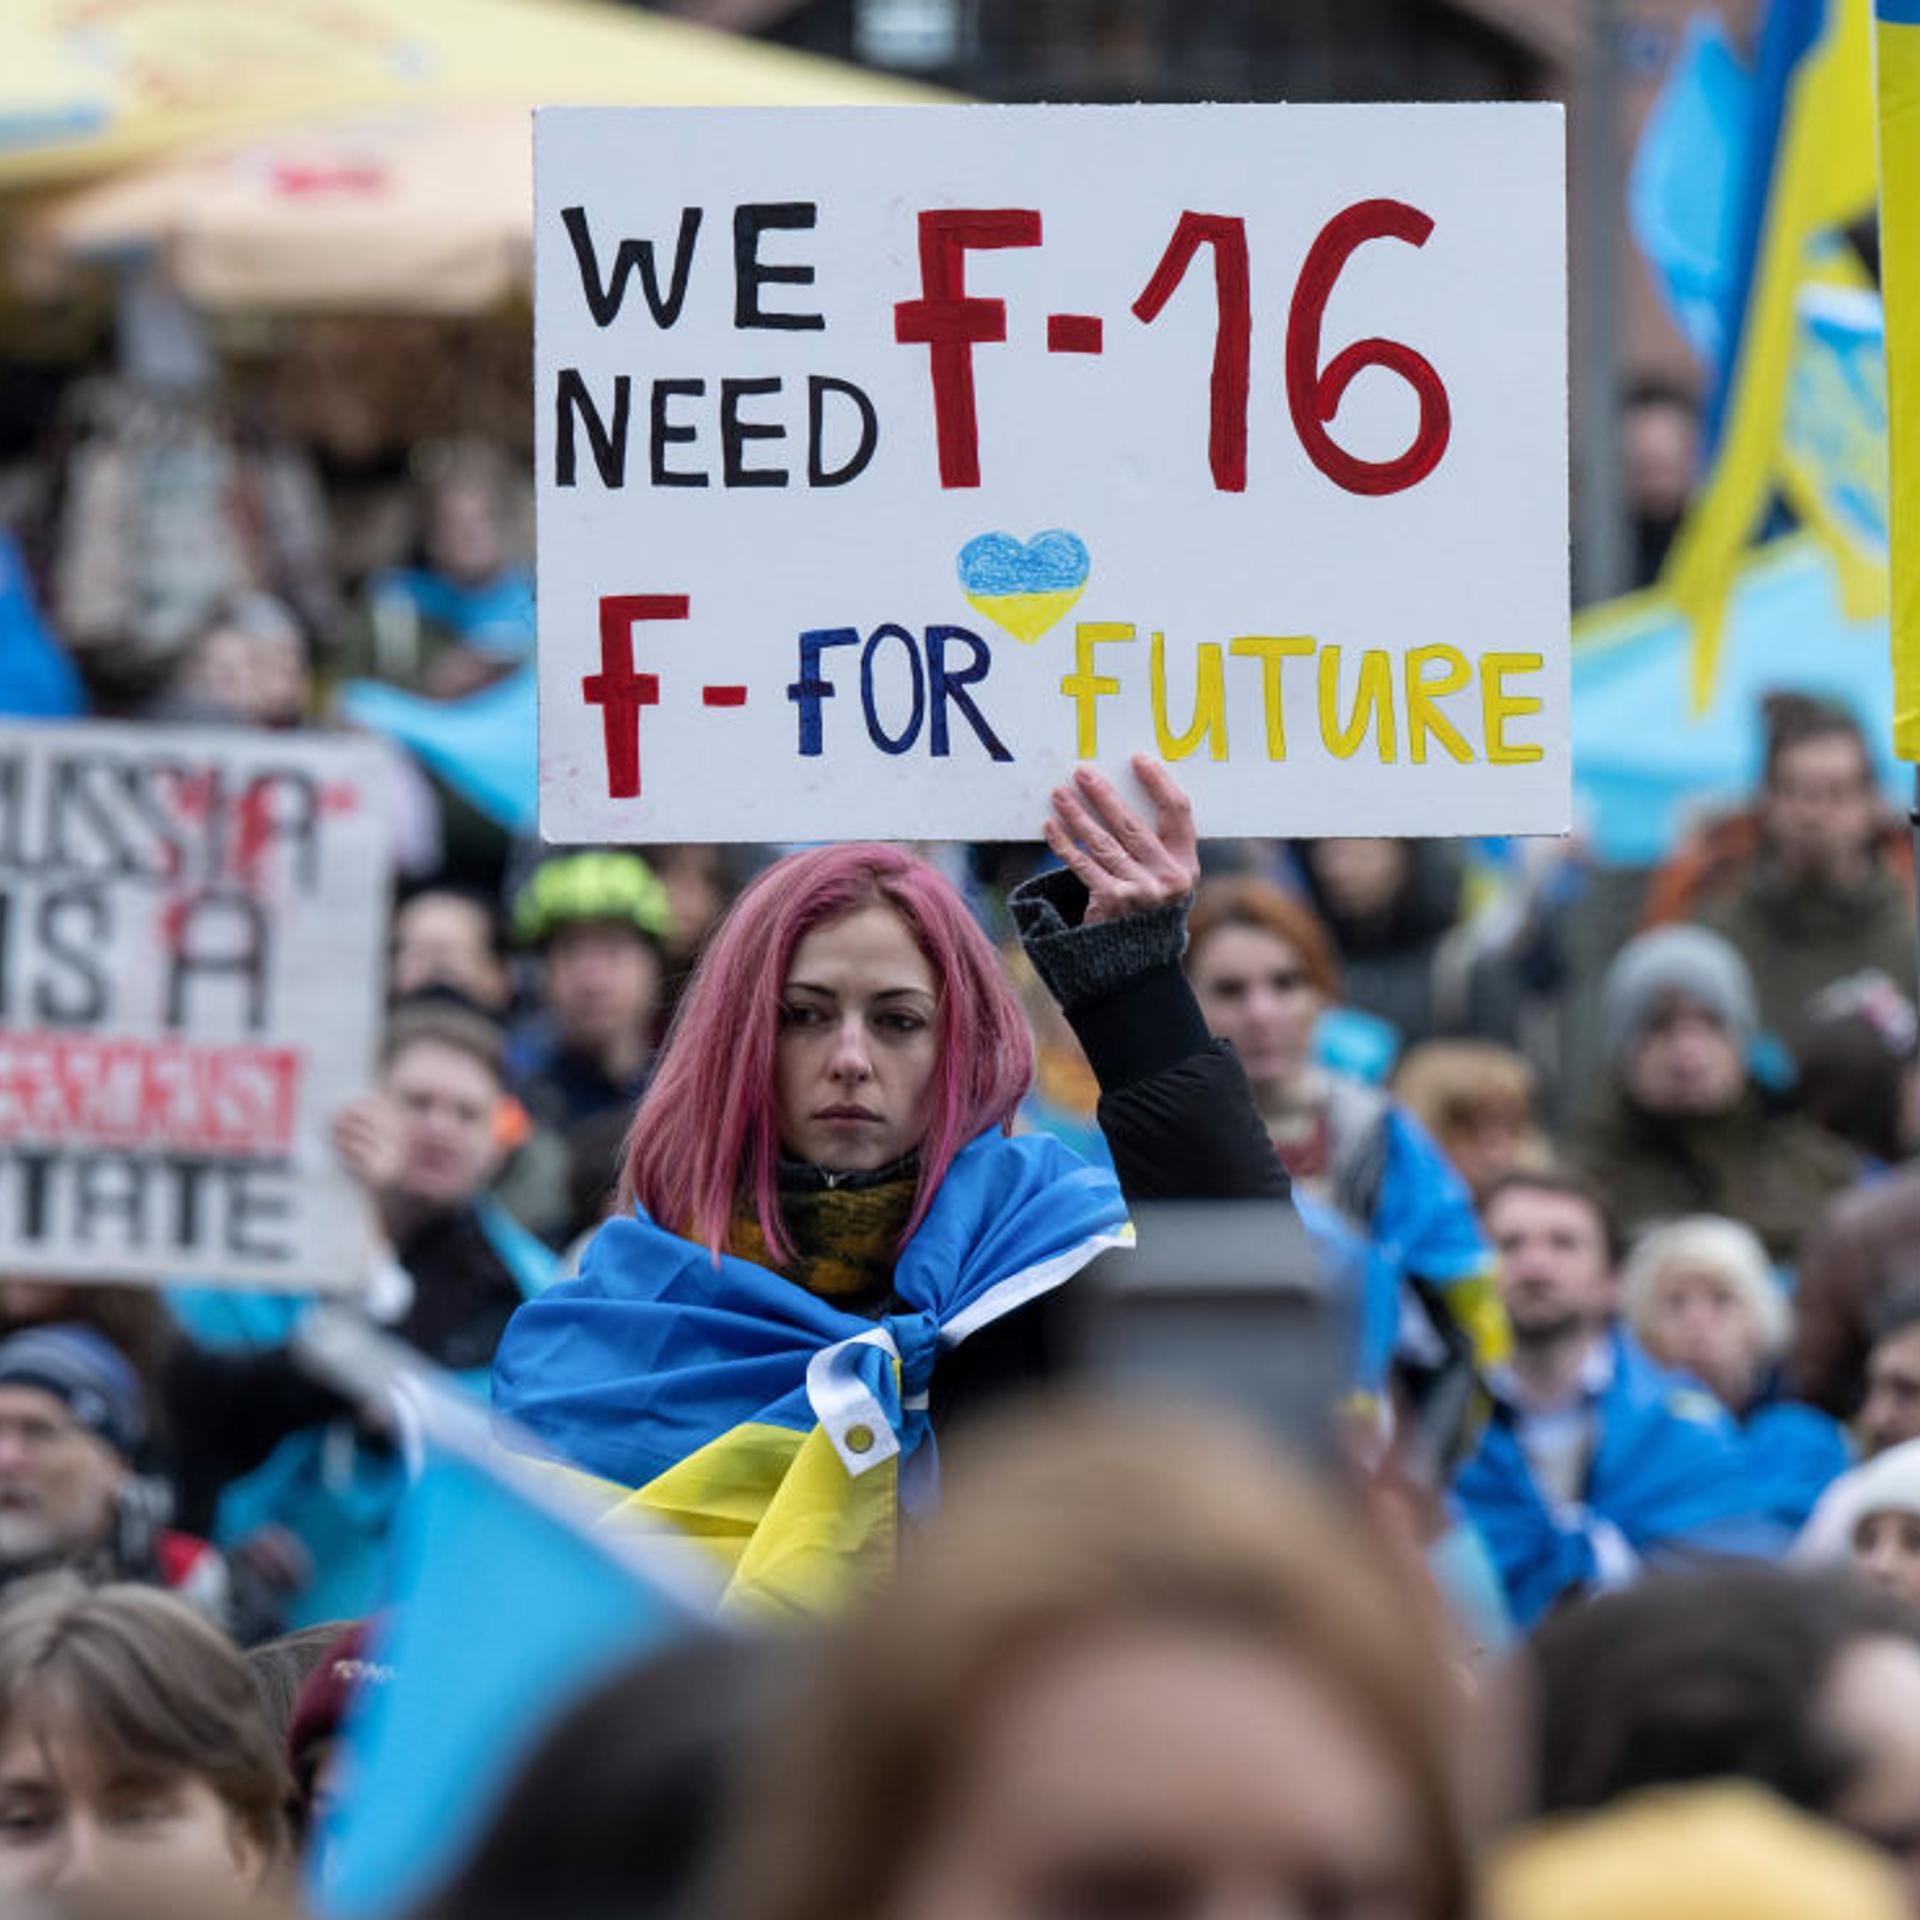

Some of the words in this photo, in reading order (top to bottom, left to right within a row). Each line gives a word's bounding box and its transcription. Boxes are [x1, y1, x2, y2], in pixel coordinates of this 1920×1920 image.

[561, 202, 825, 331] WE
[894, 199, 1451, 496] F-16
[555, 368, 878, 489] NEED
[787, 624, 1014, 762] FOR
[1060, 622, 1544, 766] FUTURE
[0, 752, 320, 888] USSIA
[160, 886, 272, 1031] A
[6, 1144, 296, 1261] TATE
